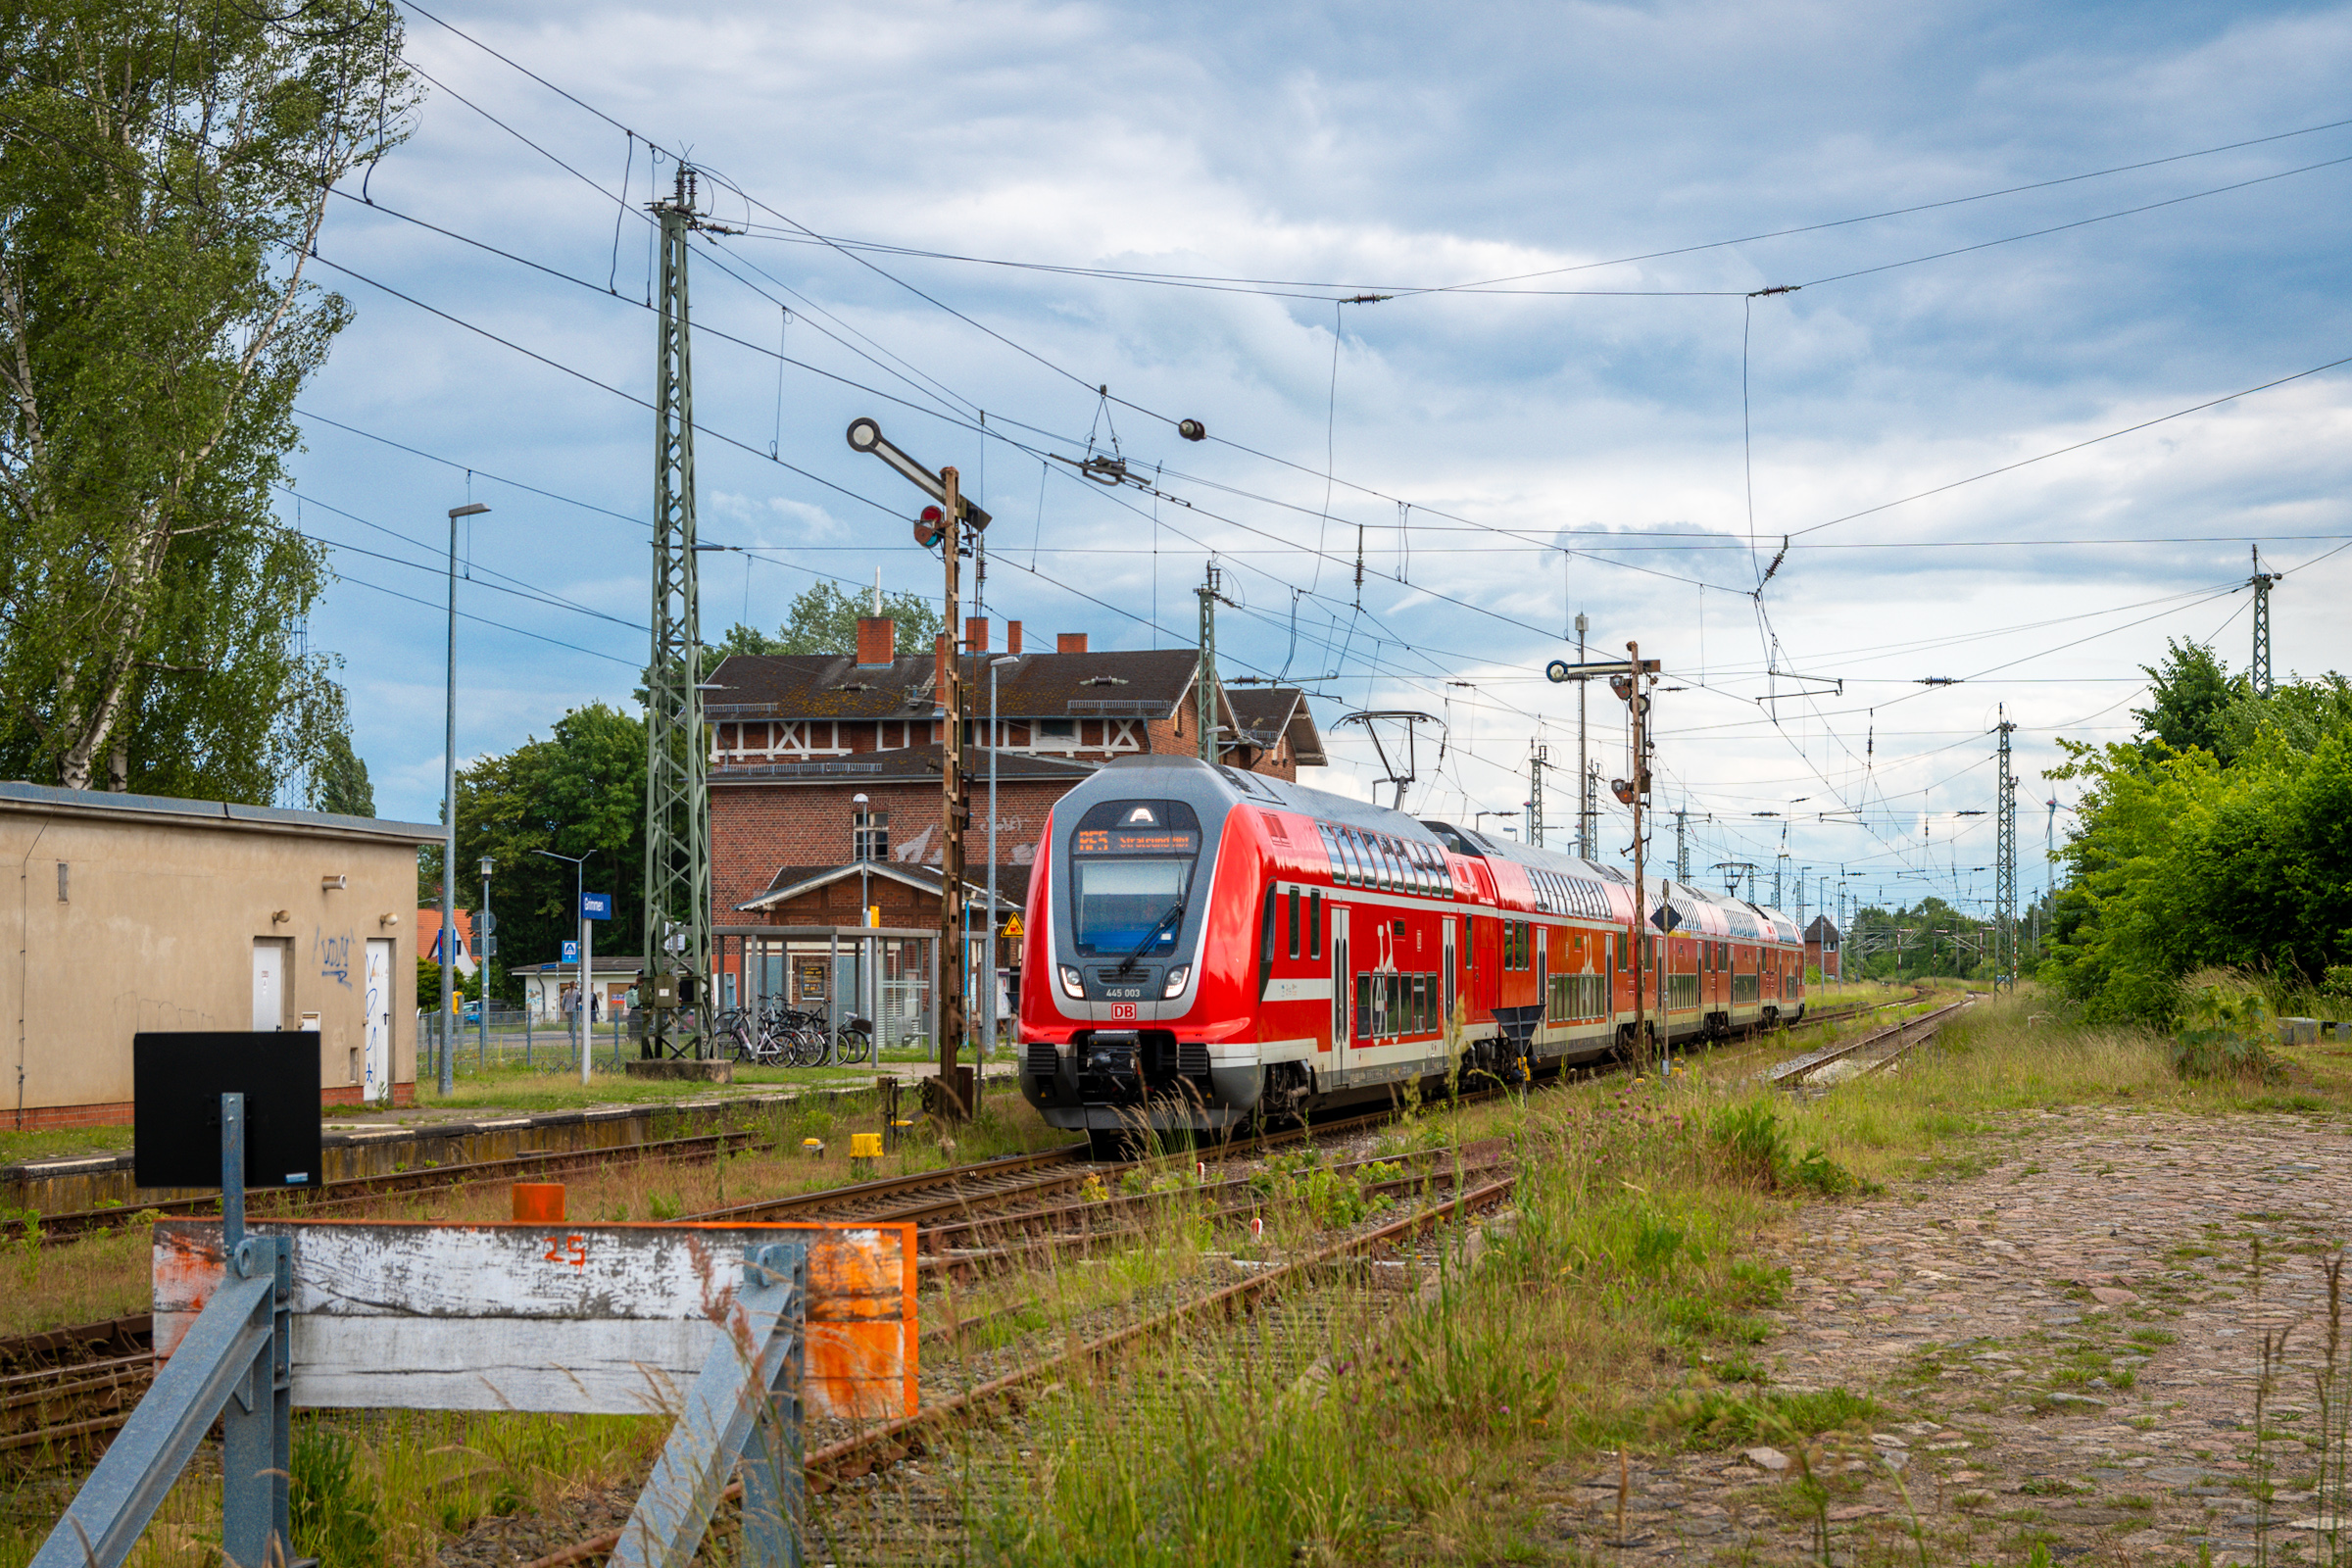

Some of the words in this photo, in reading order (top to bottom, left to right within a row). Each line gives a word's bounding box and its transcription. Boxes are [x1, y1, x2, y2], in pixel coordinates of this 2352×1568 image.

[1079, 830, 1108, 851] RE5
[1119, 836, 1170, 848] Stralsund
[584, 897, 604, 911] Grimmen
[1105, 988, 1122, 998] 445
[1124, 988, 1141, 998] 003
[1113, 1004, 1134, 1018] DB
